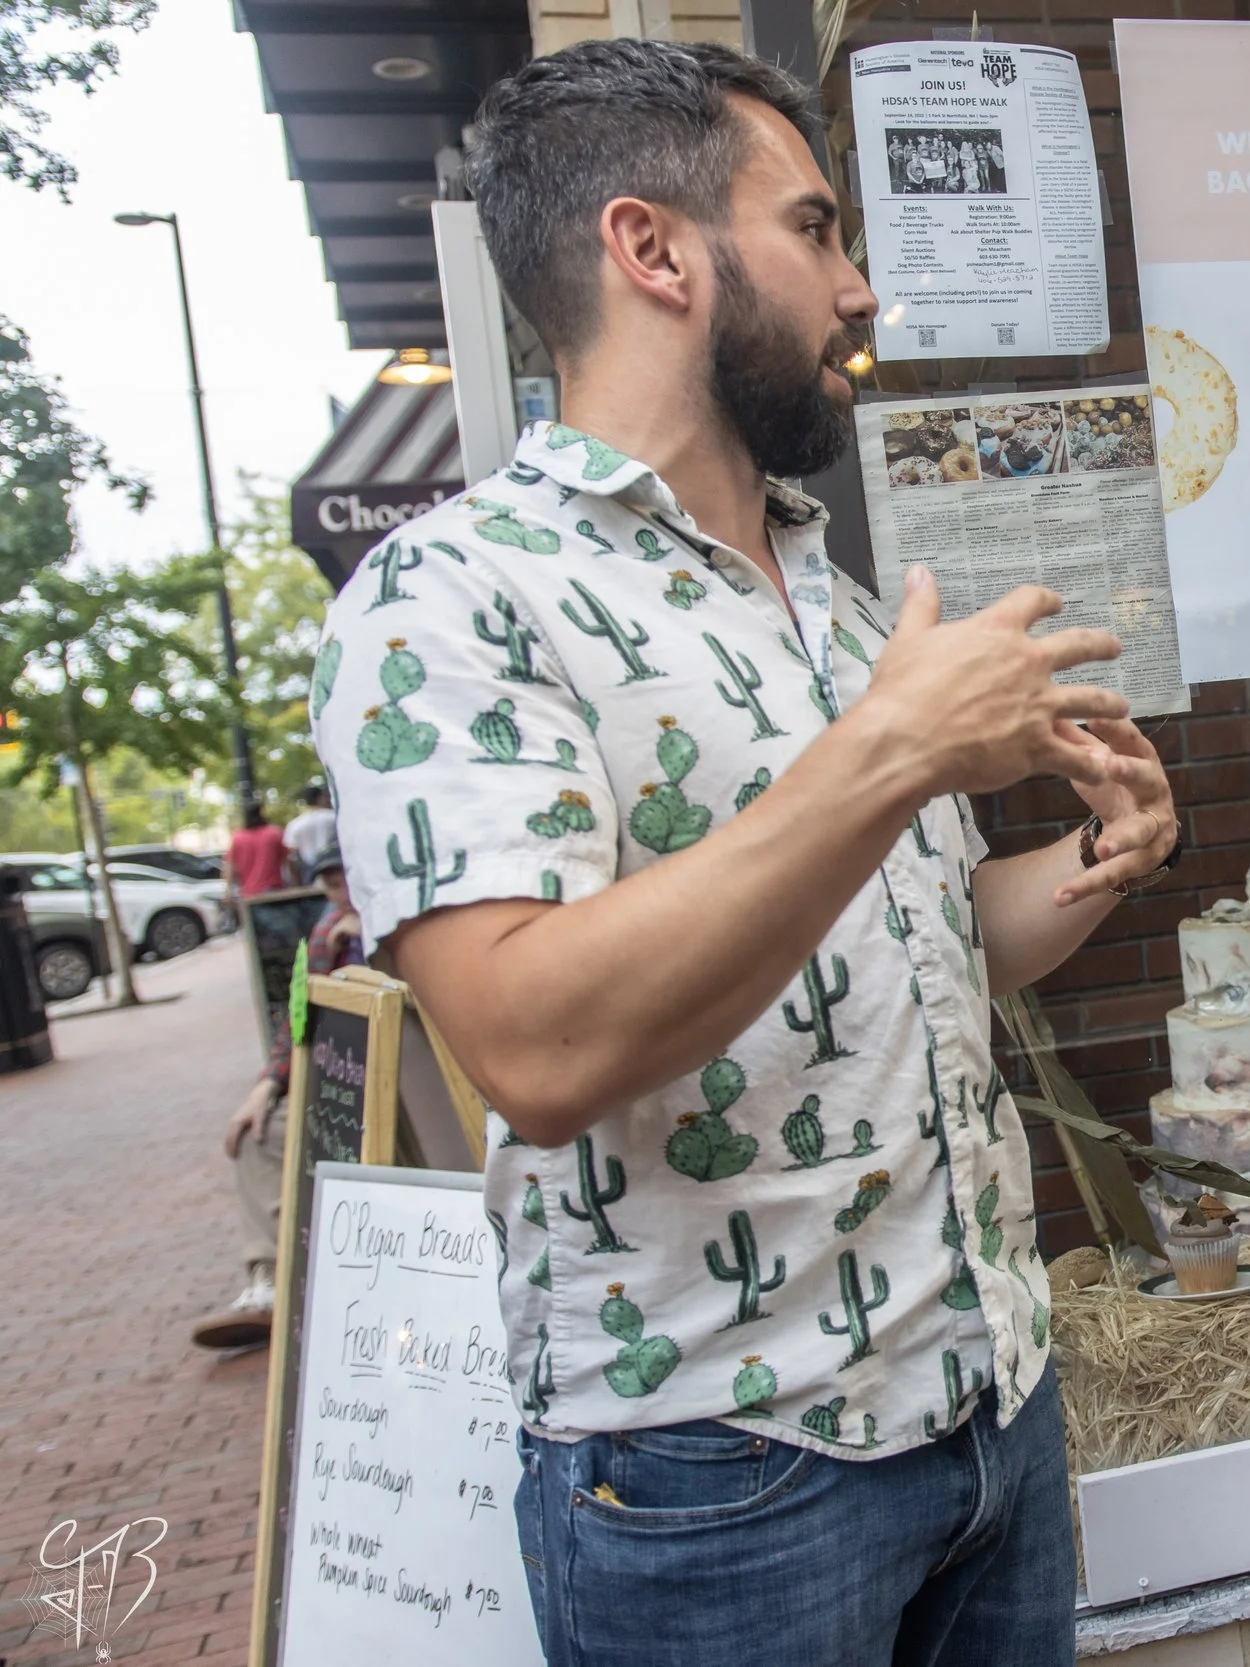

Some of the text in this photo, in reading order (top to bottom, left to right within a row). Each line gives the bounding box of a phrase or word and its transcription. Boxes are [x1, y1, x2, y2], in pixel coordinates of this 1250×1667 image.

[951, 58, 974, 67] teva
[980, 63, 1017, 78] HOPE
[983, 55, 1012, 64] TEAM
[920, 80, 966, 90] JOIN US!
[882, 96, 1008, 106] HDSA'S TEAM HOPE WALK
[968, 204, 1015, 212] Walk With Us:
[318, 489, 445, 533] Choco
[418, 1210, 488, 1266] Breads
[341, 1299, 510, 1380] Fresh Baked Brea
[318, 1386, 389, 1440] Sourdough
[312, 1441, 336, 1501] Rye
[342, 1442, 414, 1515] Sourdough
[317, 1552, 359, 1594] Pumpkin
[393, 1567, 452, 1630] Sourdough
